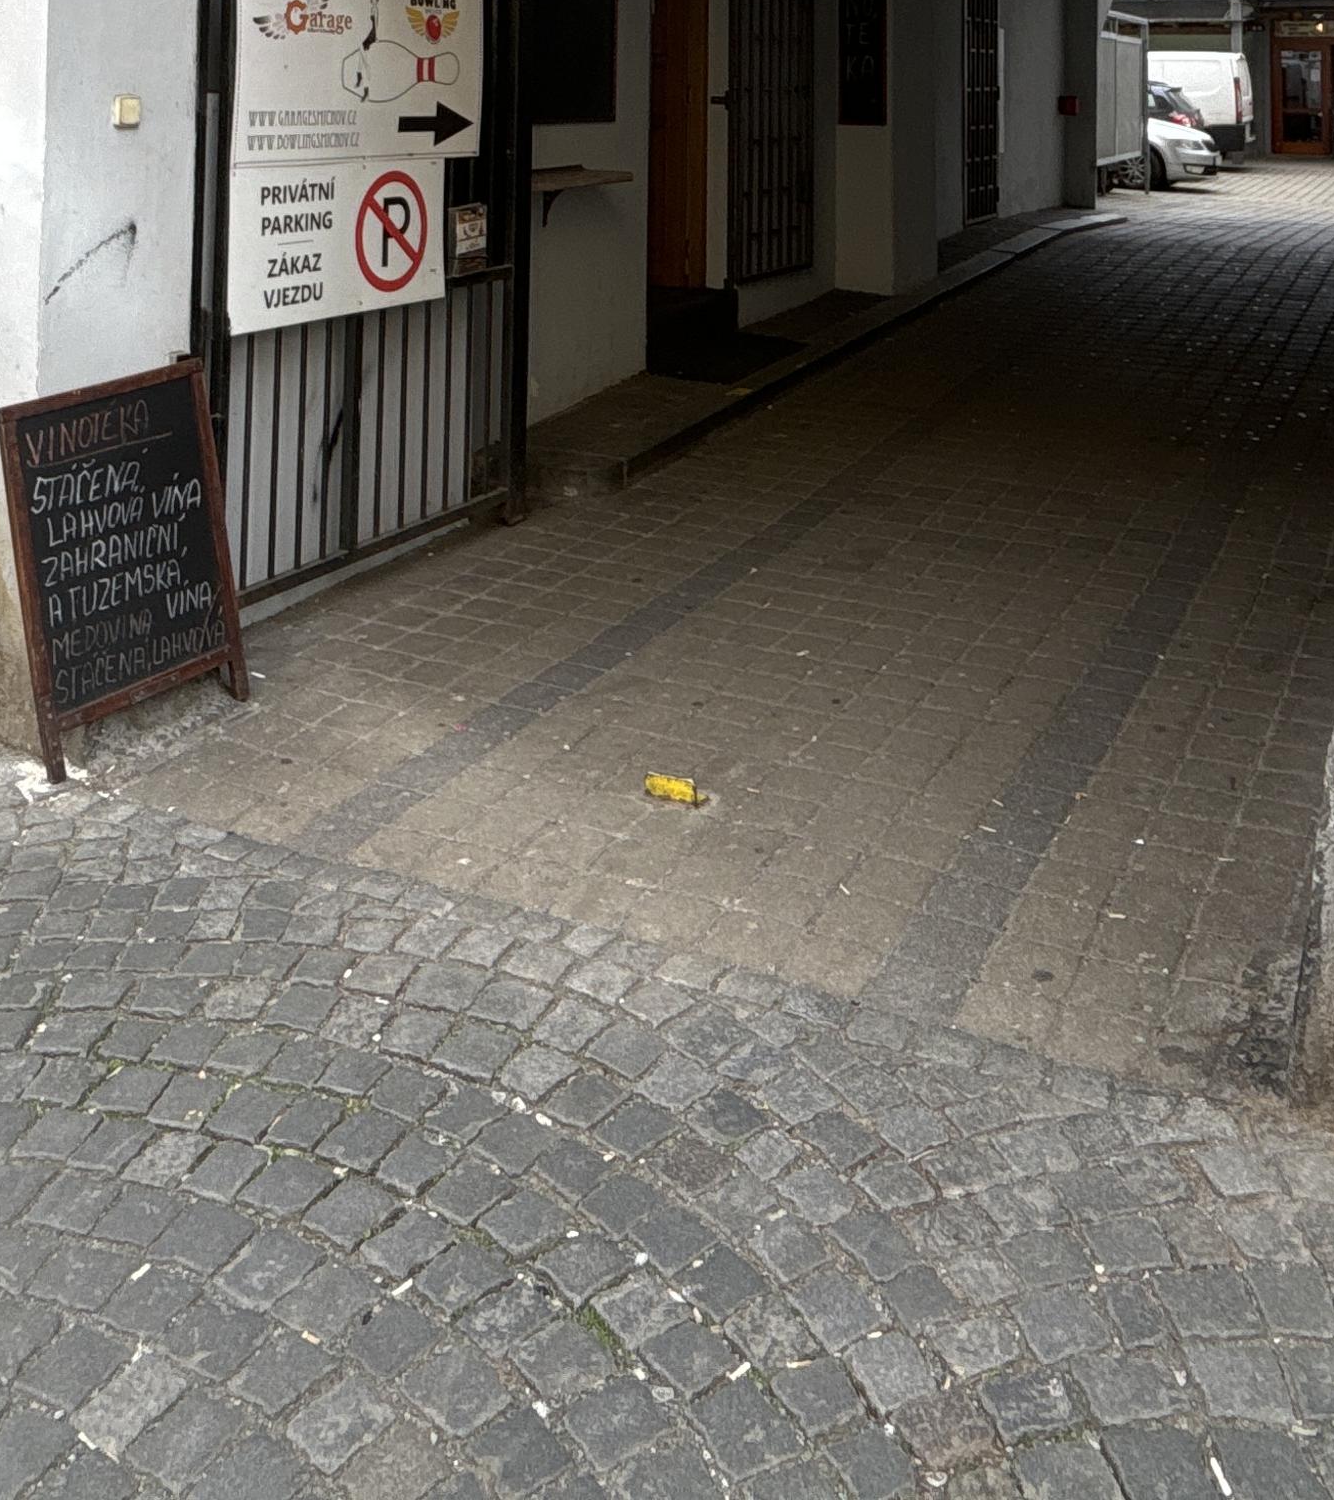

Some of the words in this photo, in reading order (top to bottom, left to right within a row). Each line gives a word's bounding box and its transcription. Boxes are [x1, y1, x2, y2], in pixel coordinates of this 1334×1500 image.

[260, 176, 336, 206] PRIVÁTNÍ
[261, 210, 334, 237] PARKING
[267, 252, 322, 279] ZÁKAZ
[264, 281, 324, 309] VJEZDU
[152, 472, 202, 519] VÍNA
